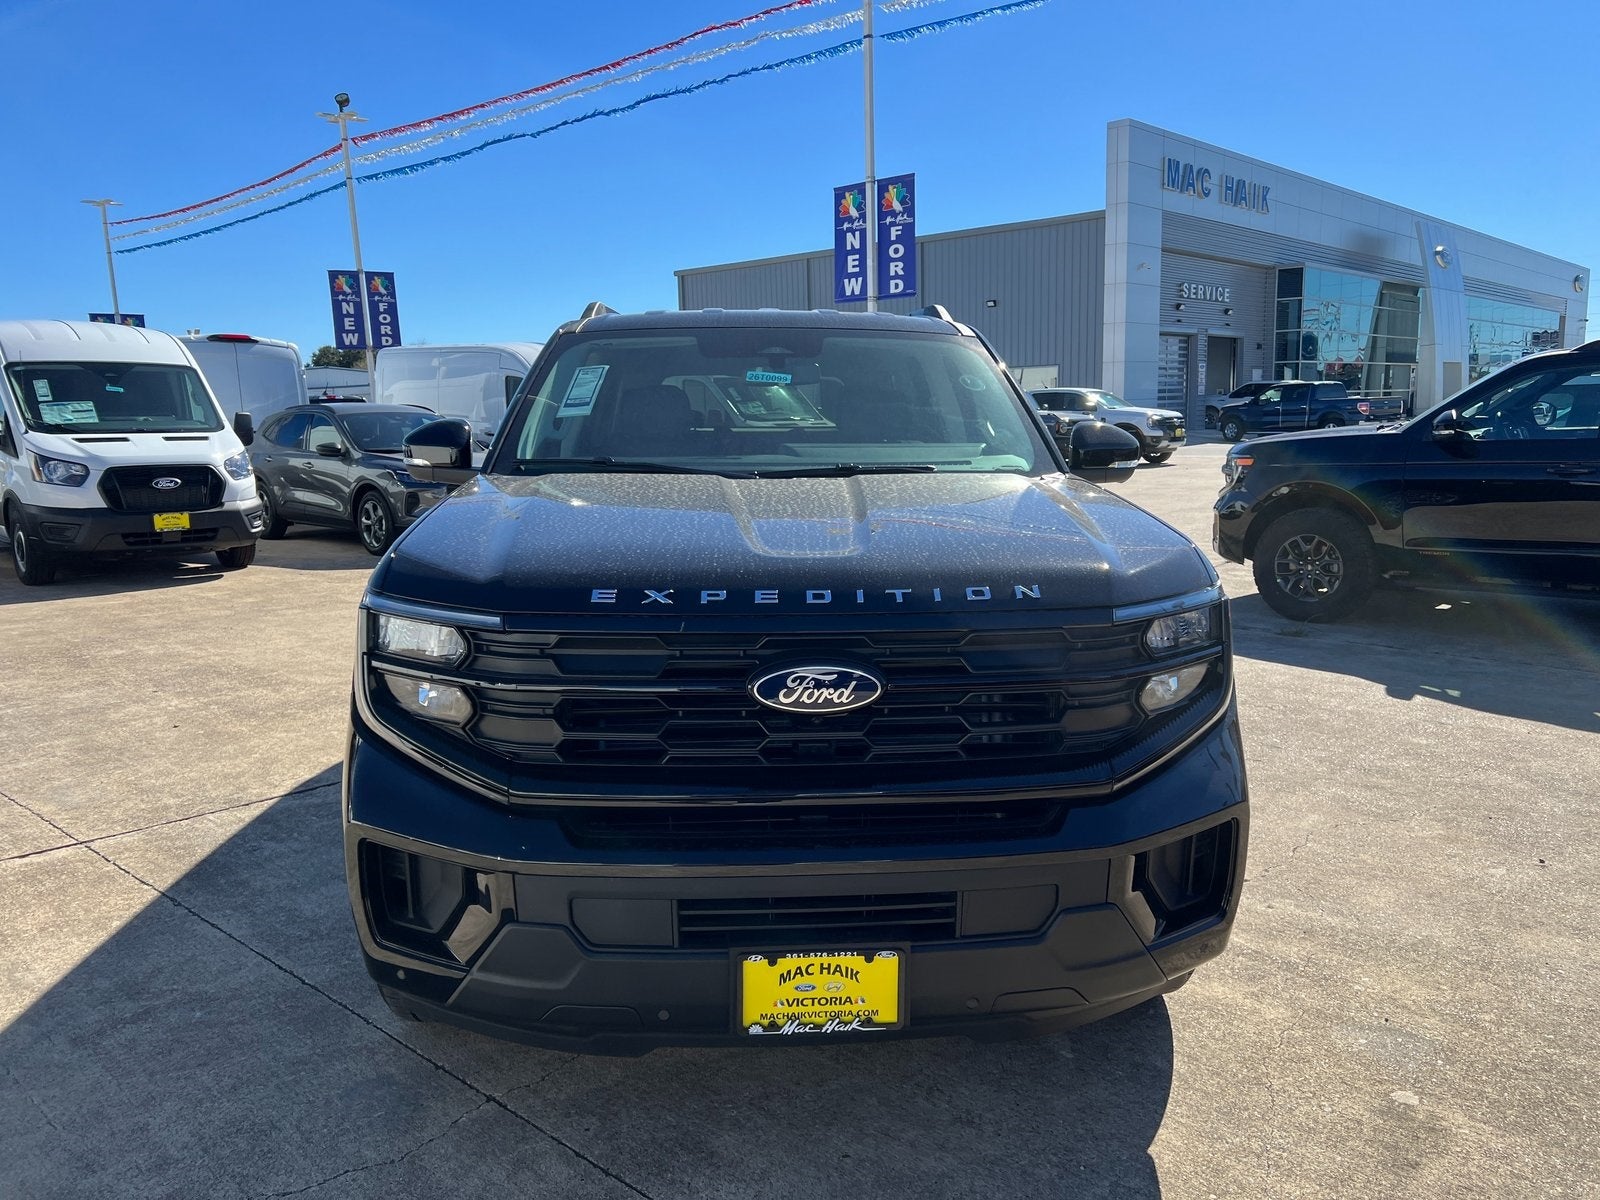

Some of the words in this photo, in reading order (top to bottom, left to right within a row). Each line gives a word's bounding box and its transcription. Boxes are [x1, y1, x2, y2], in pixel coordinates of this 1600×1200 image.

[1166, 157, 1212, 198] MAC
[1223, 174, 1271, 213] HAIK
[844, 230, 863, 297] NEW
[888, 225, 905, 294] FORD
[1181, 282, 1230, 302] SERVICE
[341, 302, 359, 346] NEW
[378, 302, 393, 346] FORD
[748, 373, 788, 382] 26T0099
[590, 585, 1042, 605] EXPEDITION
[778, 672, 855, 704] Ford
[779, 963, 815, 986] MAC
[819, 963, 861, 984] HAIK
[785, 996, 854, 1008] VICTORIA
[760, 1009, 879, 1021] MACHAIKVICTORIA.COM
[780, 1019, 820, 1035] Mac
[822, 1017, 863, 1034] Haik
